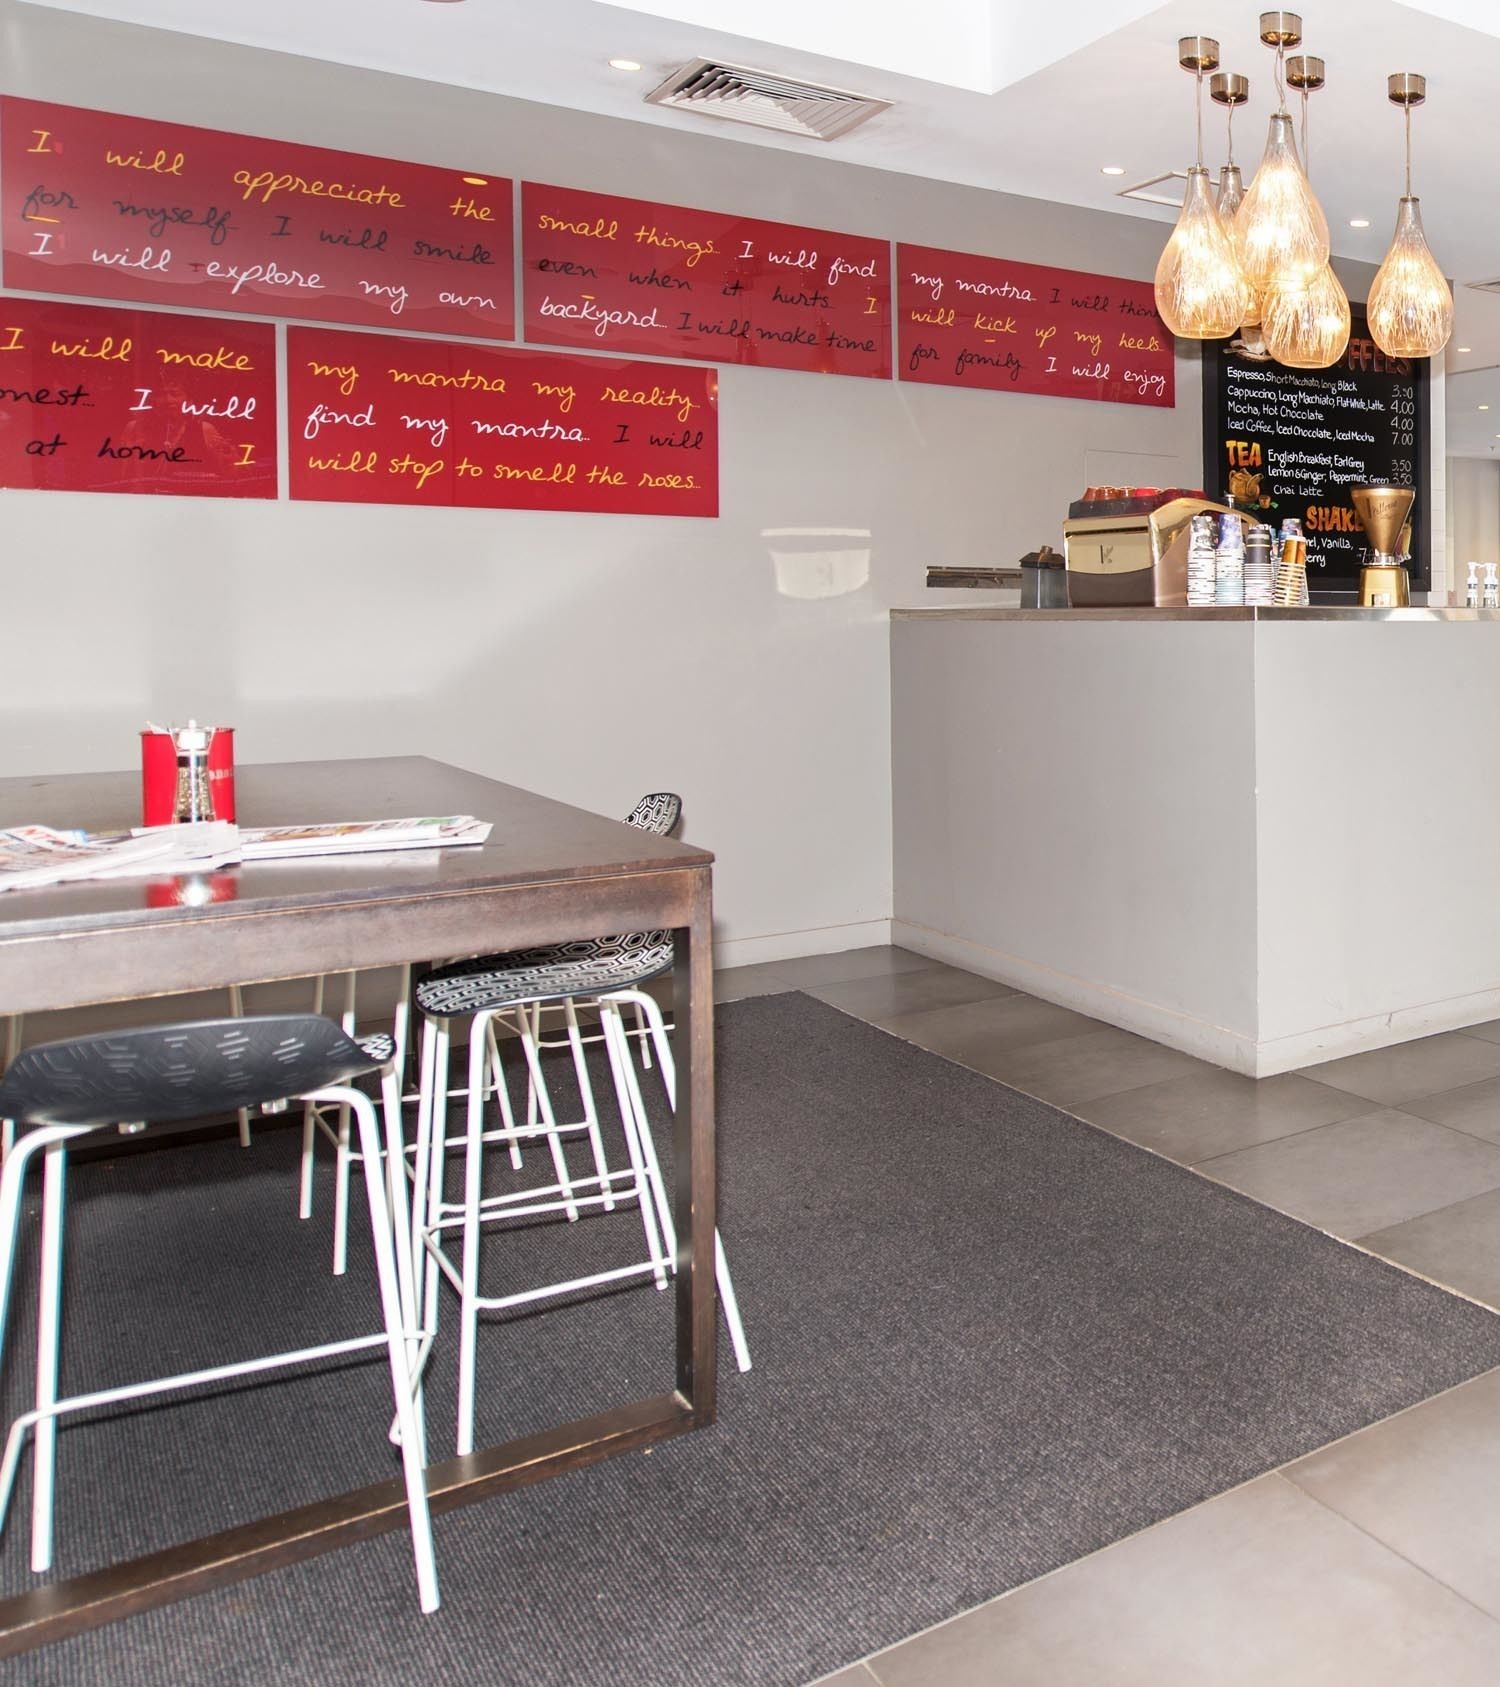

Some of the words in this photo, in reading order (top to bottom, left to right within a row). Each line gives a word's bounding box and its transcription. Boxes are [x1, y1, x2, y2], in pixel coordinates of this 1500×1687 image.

[27, 130, 52, 153] I
[106, 151, 185, 176] will
[234, 170, 406, 207] appreciate
[450, 198, 495, 221] the
[22, 185, 79, 221] for
[271, 216, 293, 236] I
[320, 225, 388, 252] will
[413, 235, 495, 266] smile
[538, 215, 618, 239] small
[738, 241, 753, 258] I
[769, 251, 817, 270] will
[828, 257, 877, 285] find
[29, 234, 53, 255] I
[92, 248, 171, 273] will
[207, 259, 326, 294] explore
[359, 279, 409, 315] my
[440, 293, 496, 310] own
[538, 259, 599, 279] even
[629, 266, 692, 291] when
[721, 280, 744, 296] it
[864, 297, 878, 314] I
[911, 273, 944, 300] my
[1049, 288, 1061, 304] I
[1071, 298, 1110, 313] will
[0, 327, 24, 350] I
[51, 337, 132, 361] will
[157, 347, 254, 370] make
[676, 312, 691, 330] I
[698, 320, 750, 340] will
[756, 326, 820, 345] make
[825, 334, 877, 352] time
[911, 309, 955, 327] will
[1035, 326, 1057, 348] up
[1074, 330, 1102, 356] my
[308, 361, 359, 395] my
[388, 369, 506, 392] mantra
[532, 382, 576, 412] my
[909, 344, 941, 371] for
[1045, 357, 1057, 373] I
[1072, 362, 1109, 380] will
[1123, 370, 1166, 396] enjoy
[1227, 366, 1265, 382] Espresso,
[1265, 371, 1288, 385] Short
[1337, 380, 1357, 392] Black
[129, 389, 152, 410] I
[182, 396, 256, 420] will
[1227, 385, 1277, 403] Cappuccino,
[1279, 390, 1298, 408] Long
[1298, 390, 1335, 408] Macchiato,
[1337, 396, 1349, 408] Flat
[1367, 399, 1386, 411] Latte
[1390, 400, 1415, 415] 4.00
[1227, 401, 1261, 416] Mocha,
[1262, 404, 1278, 415] Hot
[1280, 405, 1324, 420] Chocolate
[1390, 416, 1414, 431] 4.00
[304, 405, 377, 439] find
[401, 415, 449, 447] my
[612, 425, 630, 443] I
[649, 430, 704, 450] will
[1227, 417, 1245, 430] Iced
[1246, 419, 1275, 435] Coffee,
[1276, 420, 1293, 435] Iced
[1293, 425, 1336, 442] Chocolate,
[1336, 429, 1351, 441] Iced
[1351, 431, 1375, 443] Mocha
[1391, 432, 1414, 446] 7.00
[25, 433, 68, 456] at
[234, 445, 256, 466] I
[1226, 440, 1262, 467] TEA
[1268, 449, 1298, 469] English
[1299, 451, 1333, 468] Breakfast,
[1334, 454, 1349, 467] Earl
[1349, 457, 1365, 473] Grey
[1391, 459, 1412, 472] 3.50
[308, 451, 377, 474] will
[389, 456, 444, 489] stop
[455, 458, 483, 478] to
[494, 463, 576, 484] smell
[586, 466, 627, 485] the
[1268, 466, 1295, 478] Lemon
[1300, 469, 1327, 485] Ginger,
[1329, 470, 1368, 485] Peppermint,
[1369, 475, 1389, 484] Green
[1393, 473, 1413, 485] 3.50
[1273, 484, 1295, 495] Chai
[1299, 485, 1325, 497] Latte
[1321, 537, 1354, 551] Vanilla,
